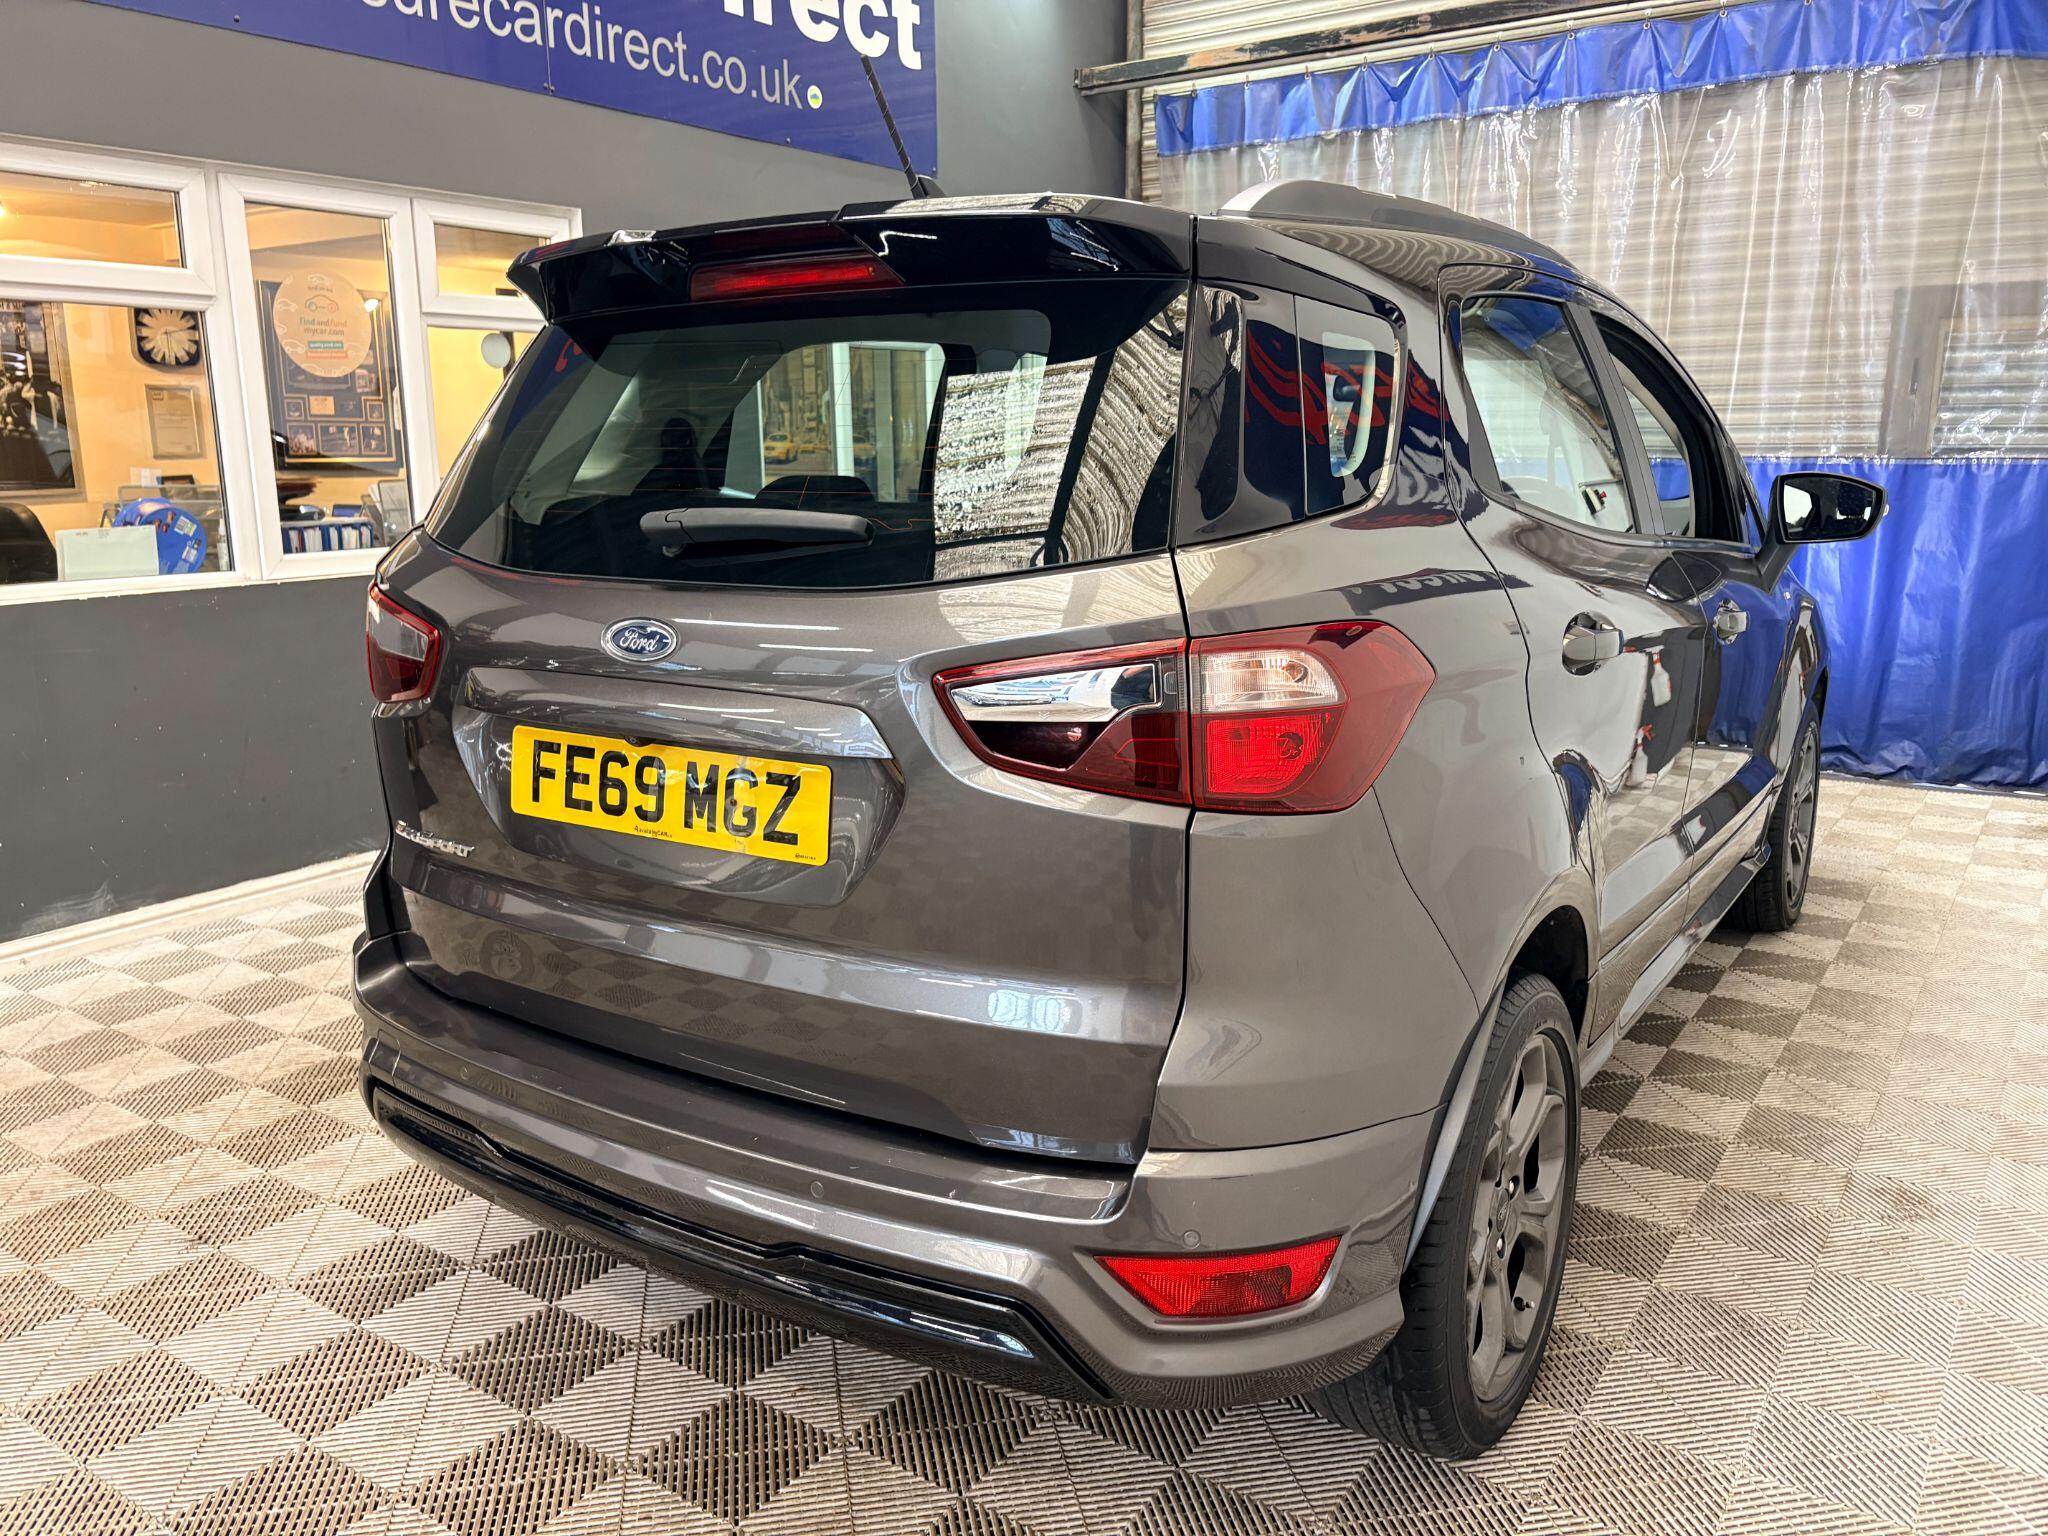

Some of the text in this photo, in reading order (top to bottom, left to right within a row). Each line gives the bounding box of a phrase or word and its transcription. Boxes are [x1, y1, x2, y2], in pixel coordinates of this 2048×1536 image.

[362, 0, 803, 109] ecardirect.co.uk
[619, 626, 660, 652] Ford
[532, 739, 802, 846] FE69 MGZ
